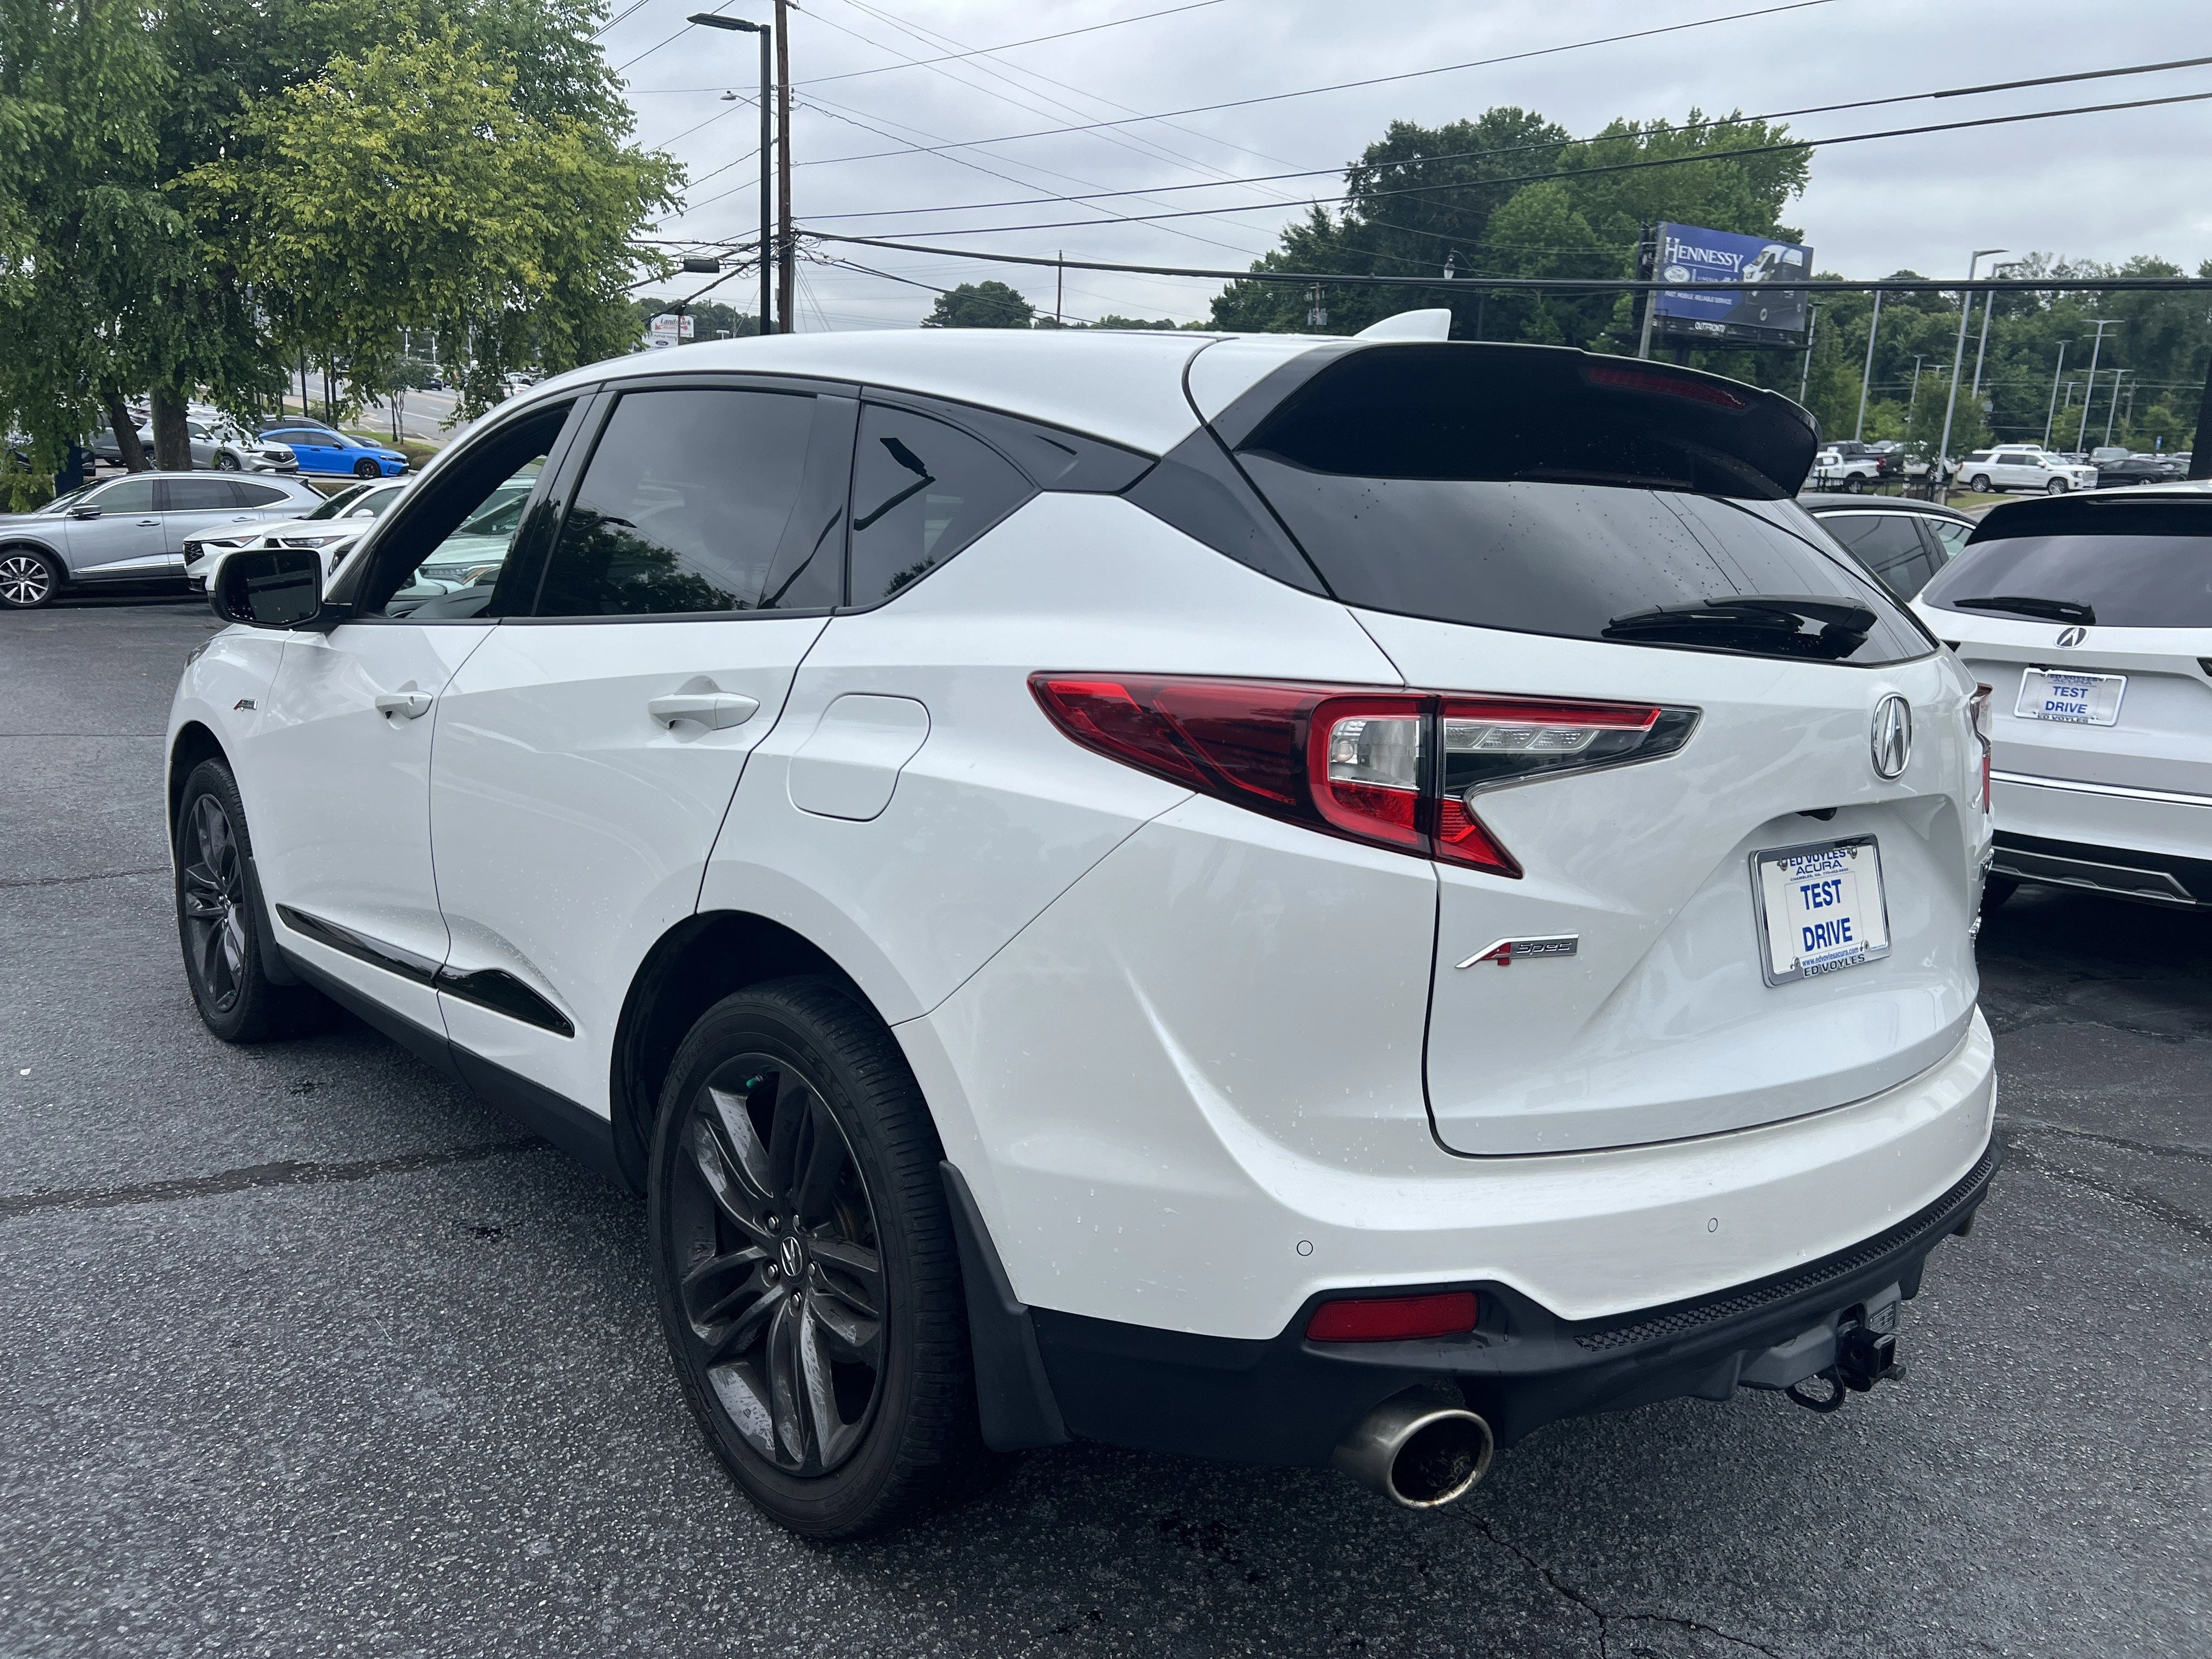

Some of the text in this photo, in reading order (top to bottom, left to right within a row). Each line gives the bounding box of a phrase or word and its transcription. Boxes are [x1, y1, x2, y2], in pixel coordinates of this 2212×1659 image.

[1664, 237, 1745, 273] HENNESSY
[2053, 686, 2089, 698] TEST
[2045, 700, 2088, 714] DRIVE
[1796, 859, 1842, 876] ACURA
[1800, 879, 1842, 910] TEST
[1802, 917, 1853, 952] DRIVE
[1804, 953, 1865, 977] ED VOYLES
